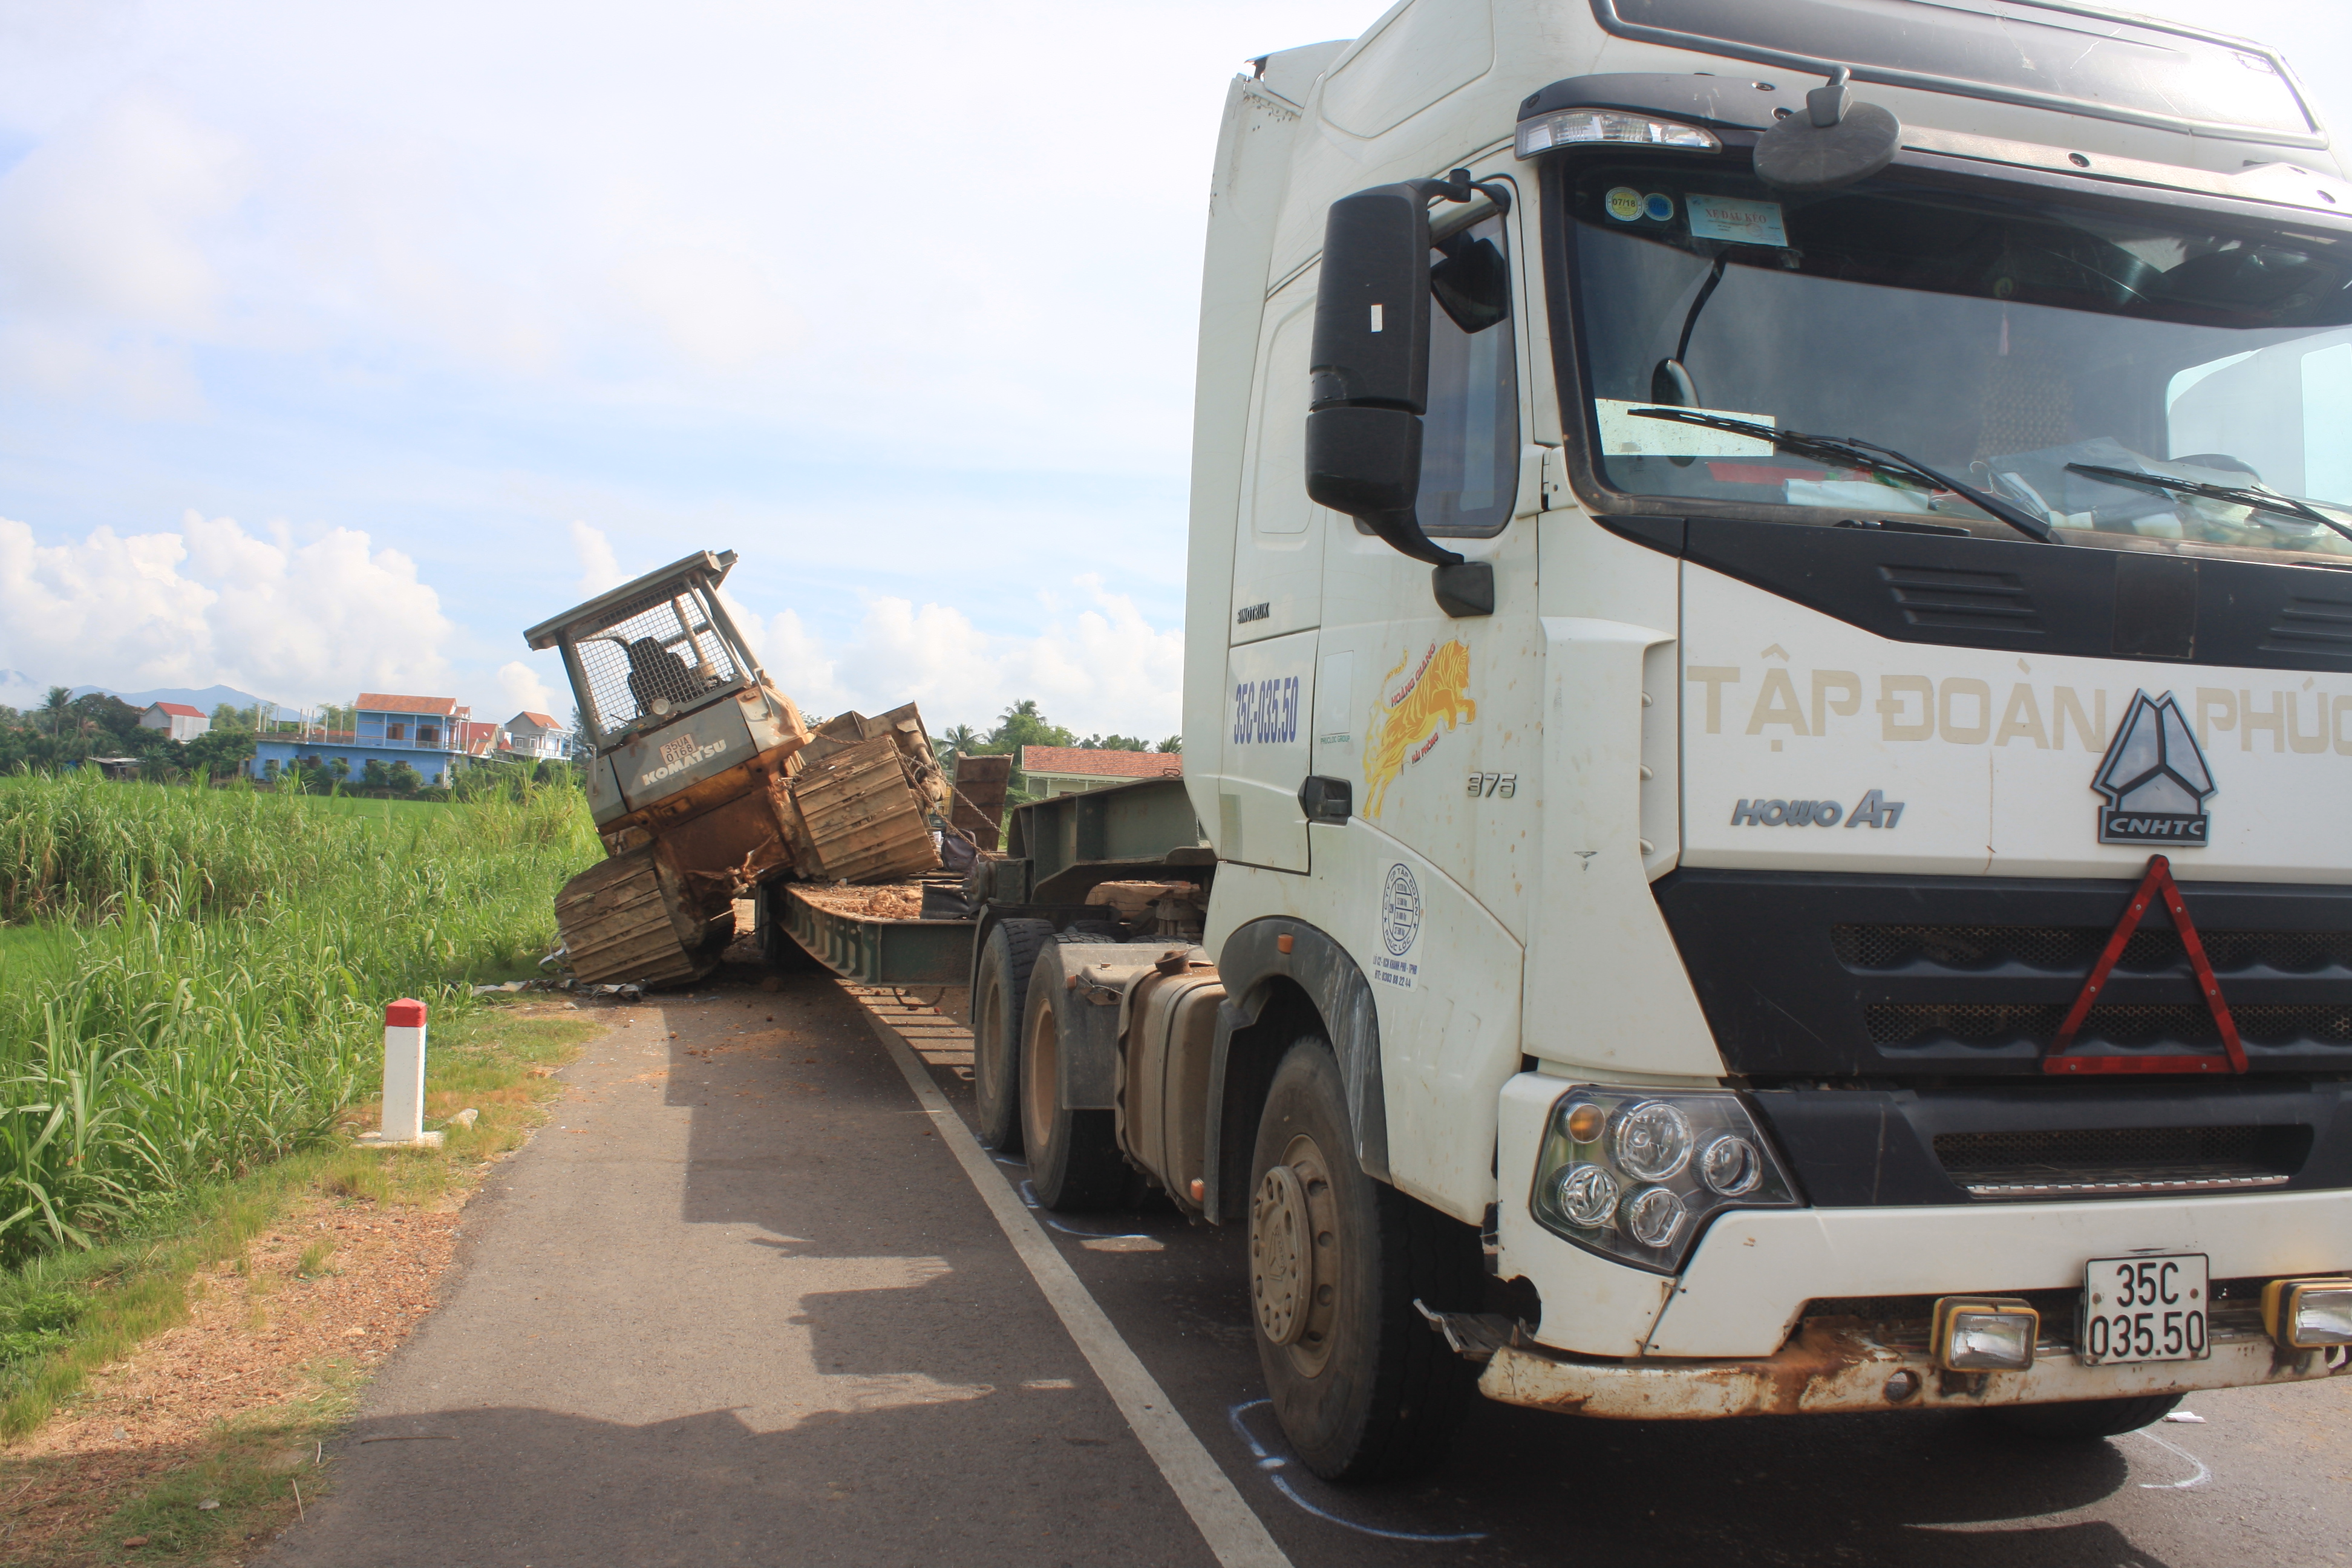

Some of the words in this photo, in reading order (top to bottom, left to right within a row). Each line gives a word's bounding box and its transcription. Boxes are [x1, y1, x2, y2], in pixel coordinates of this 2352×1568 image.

[1612, 198, 1636, 207] 07/18
[1705, 208, 1719, 218] XE
[1237, 602, 1270, 624] SINOTRUK
[1391, 678, 1416, 707] HOÀNG
[1415, 642, 1436, 682] GIANG
[1233, 675, 1299, 745] 35C-035.50
[1686, 642, 1862, 753] TẬP
[1876, 658, 2106, 754] ĐOÀN
[665, 736, 690, 753] 35UA
[666, 743, 693, 762] 0168
[642, 739, 727, 786] KOMATSU
[1466, 772, 1517, 799] 375
[1730, 799, 1843, 827] HOWO
[1844, 789, 1906, 828] A7
[2108, 817, 2204, 836] CNHTC
[1399, 975, 1405, 987] 22
[1405, 977, 1411, 988] 44
[2115, 1261, 2179, 1308] 35C
[2088, 1309, 2205, 1357] 035.50
